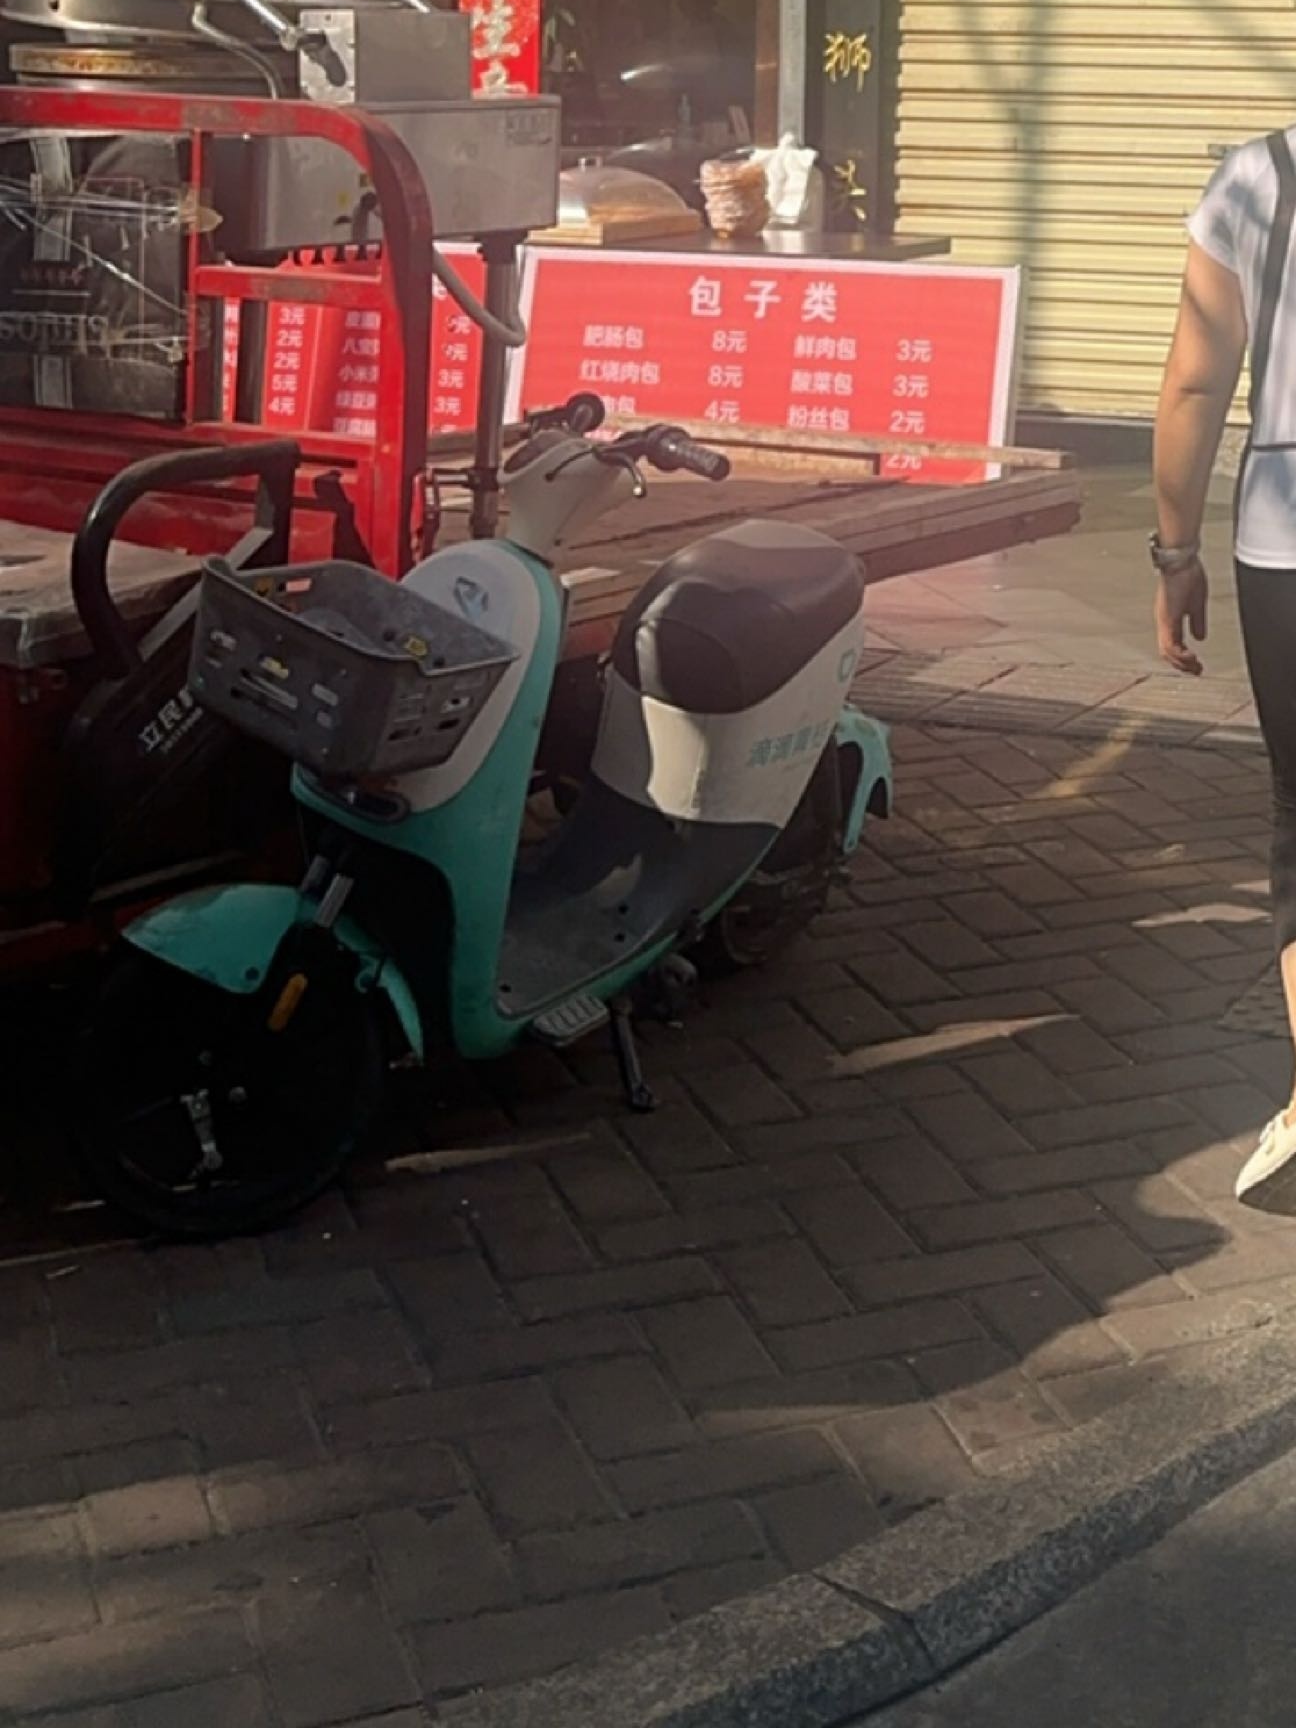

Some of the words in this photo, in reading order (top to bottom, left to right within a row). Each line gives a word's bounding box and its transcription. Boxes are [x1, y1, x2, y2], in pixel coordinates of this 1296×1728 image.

[688, 277, 838, 323] 包子类
[711, 329, 748, 353] 8元
[794, 334, 857, 361] 鲜肉包
[896, 338, 932, 363] 3元
[578, 358, 661, 384] 红烧肉包
[707, 363, 744, 388] 8元
[892, 373, 928, 398] 3元
[704, 399, 740, 424] 4元
[888, 409, 925, 434] 2元
